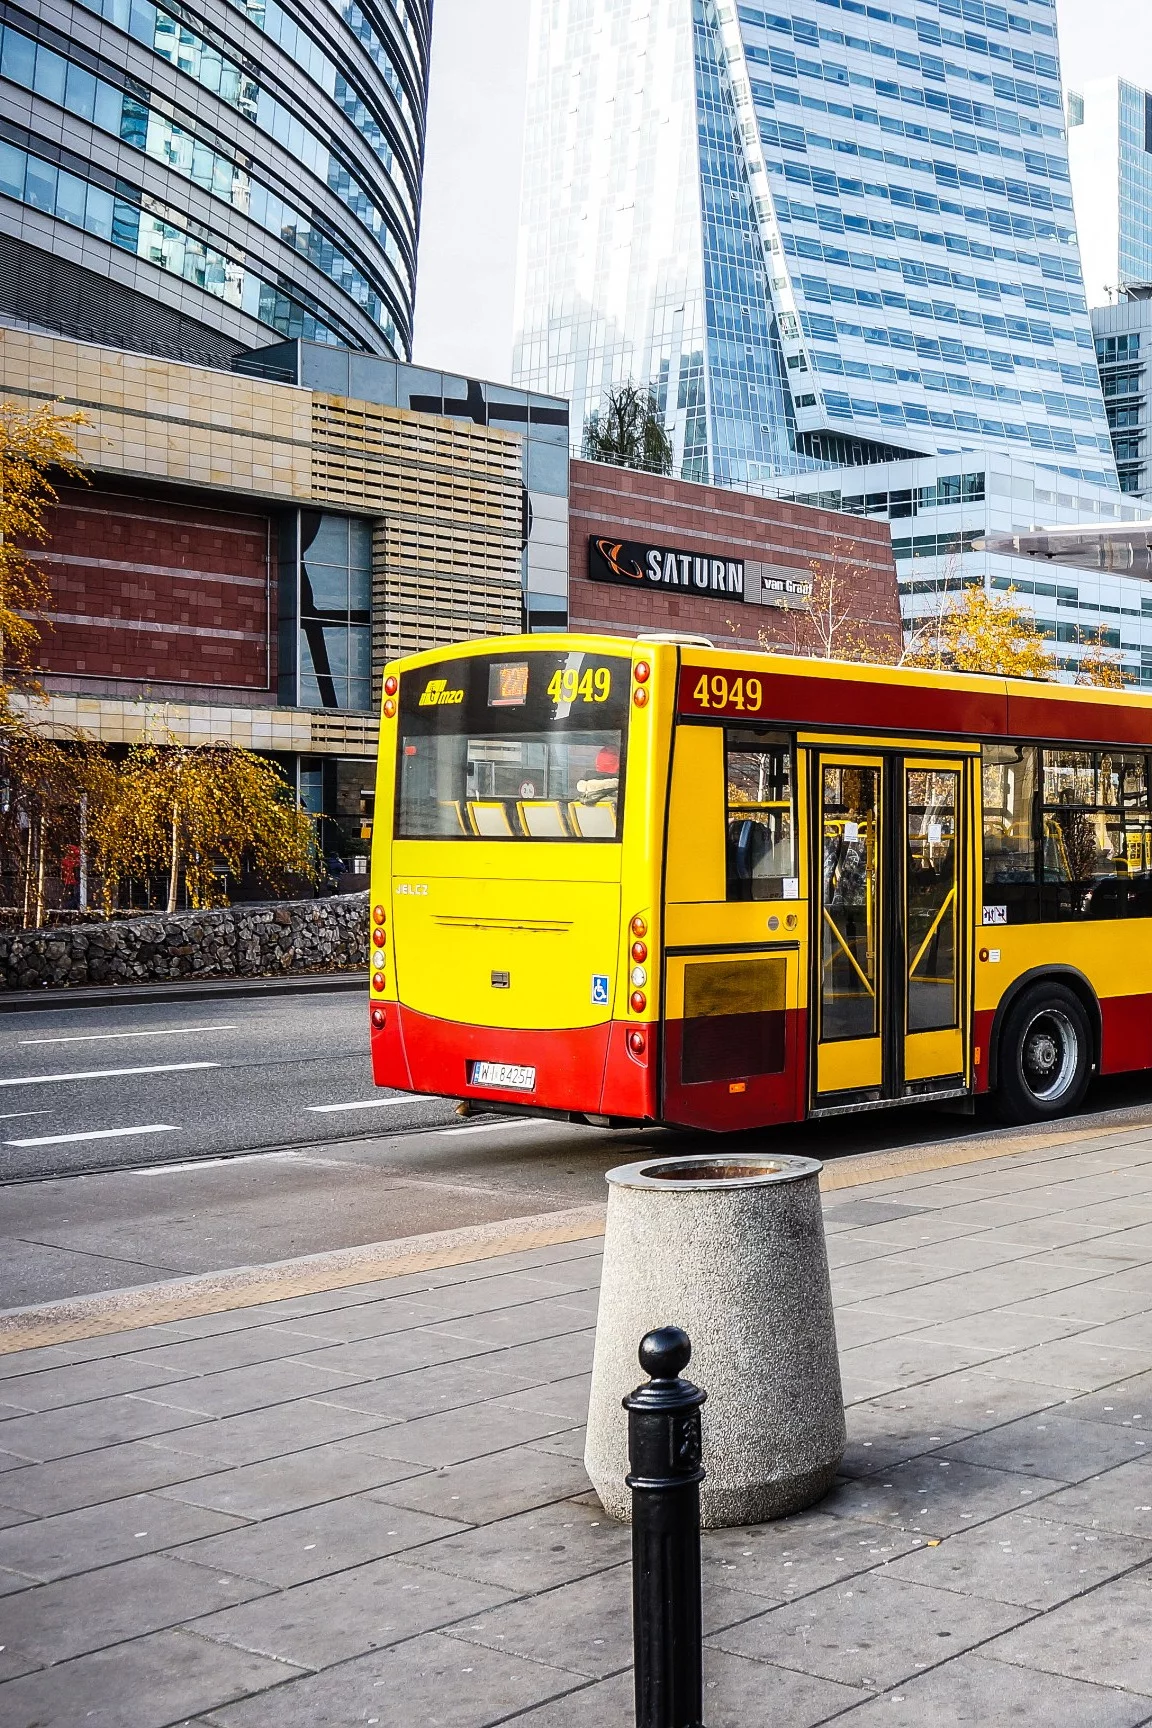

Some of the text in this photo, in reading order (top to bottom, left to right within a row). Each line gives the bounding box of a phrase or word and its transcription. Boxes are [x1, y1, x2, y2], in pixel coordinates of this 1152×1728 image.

[645, 550, 743, 593] SATURN
[764, 578, 784, 592] van
[547, 667, 611, 705] 4949
[693, 674, 763, 712] 4949
[396, 883, 429, 896] JELCZ
